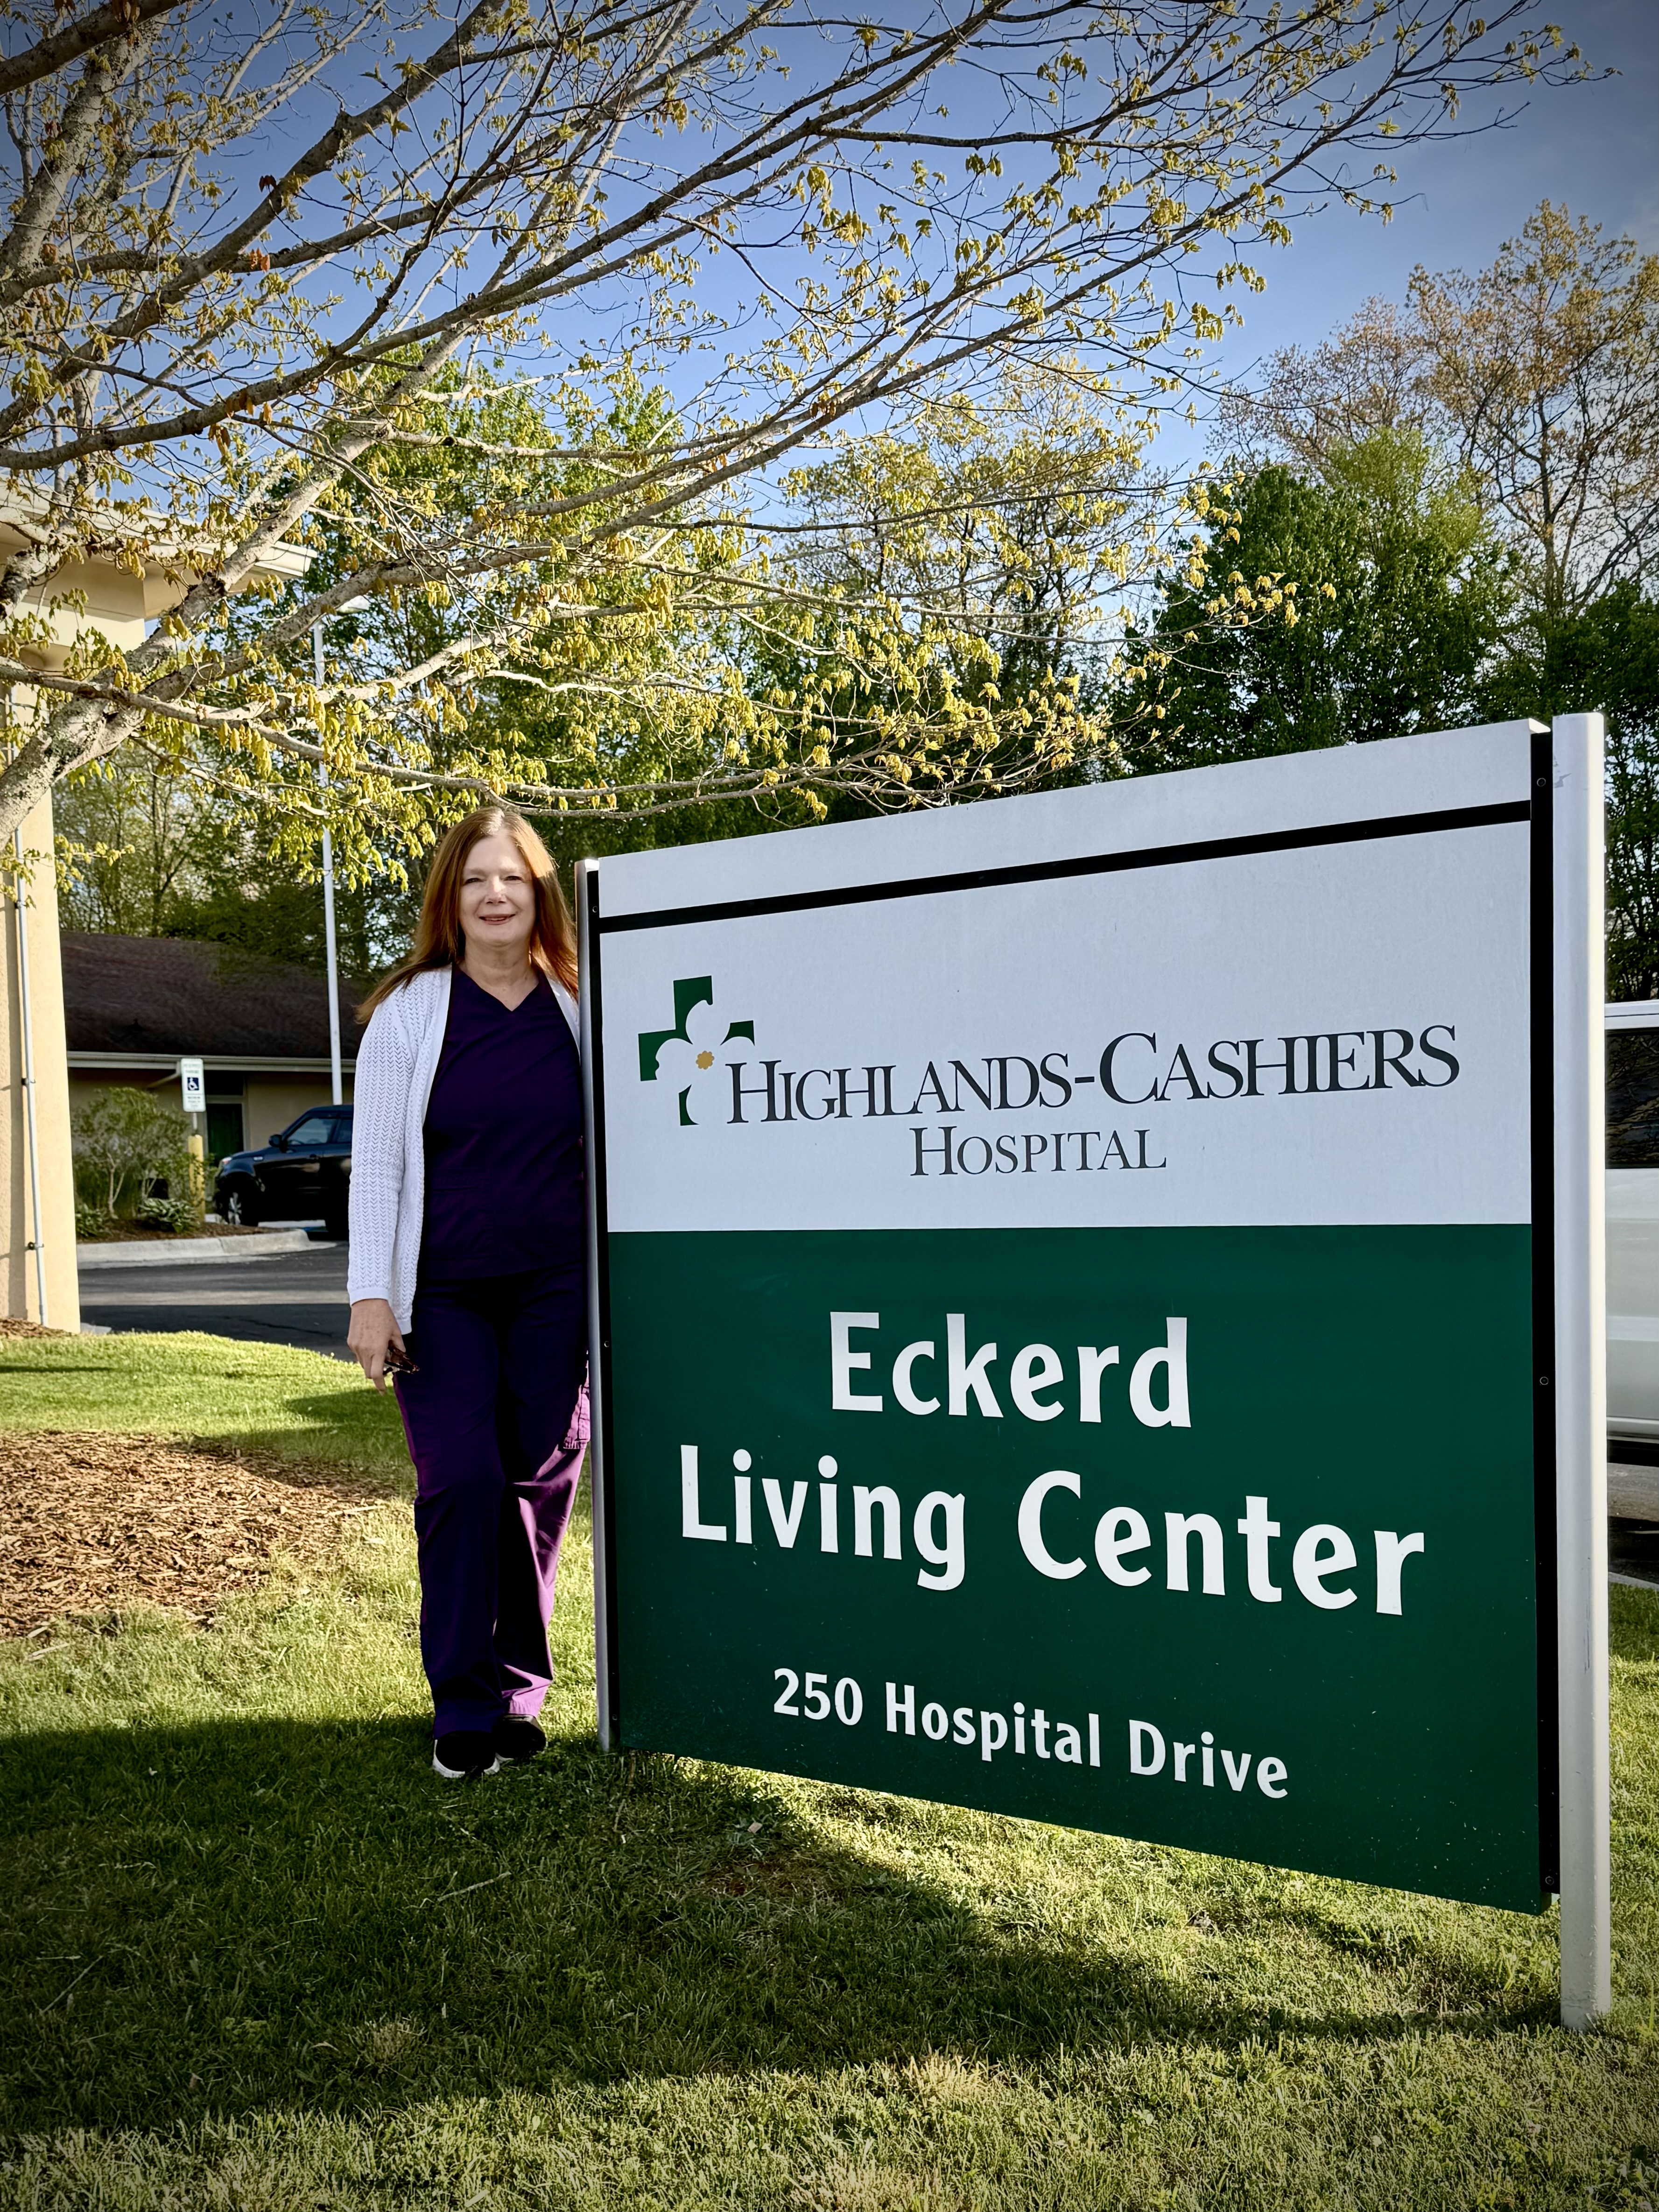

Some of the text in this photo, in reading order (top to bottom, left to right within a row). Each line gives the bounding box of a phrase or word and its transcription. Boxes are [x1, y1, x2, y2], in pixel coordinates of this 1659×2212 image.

[725, 1025, 1460, 1124] HIGHLANDS-CASHIERS
[909, 1126, 1168, 1176] HOSPITAL
[830, 1311, 1191, 1428] Eckerd
[681, 1444, 1424, 1615] Living Center
[774, 1668, 1288, 1798] 250 Hospital Drive
